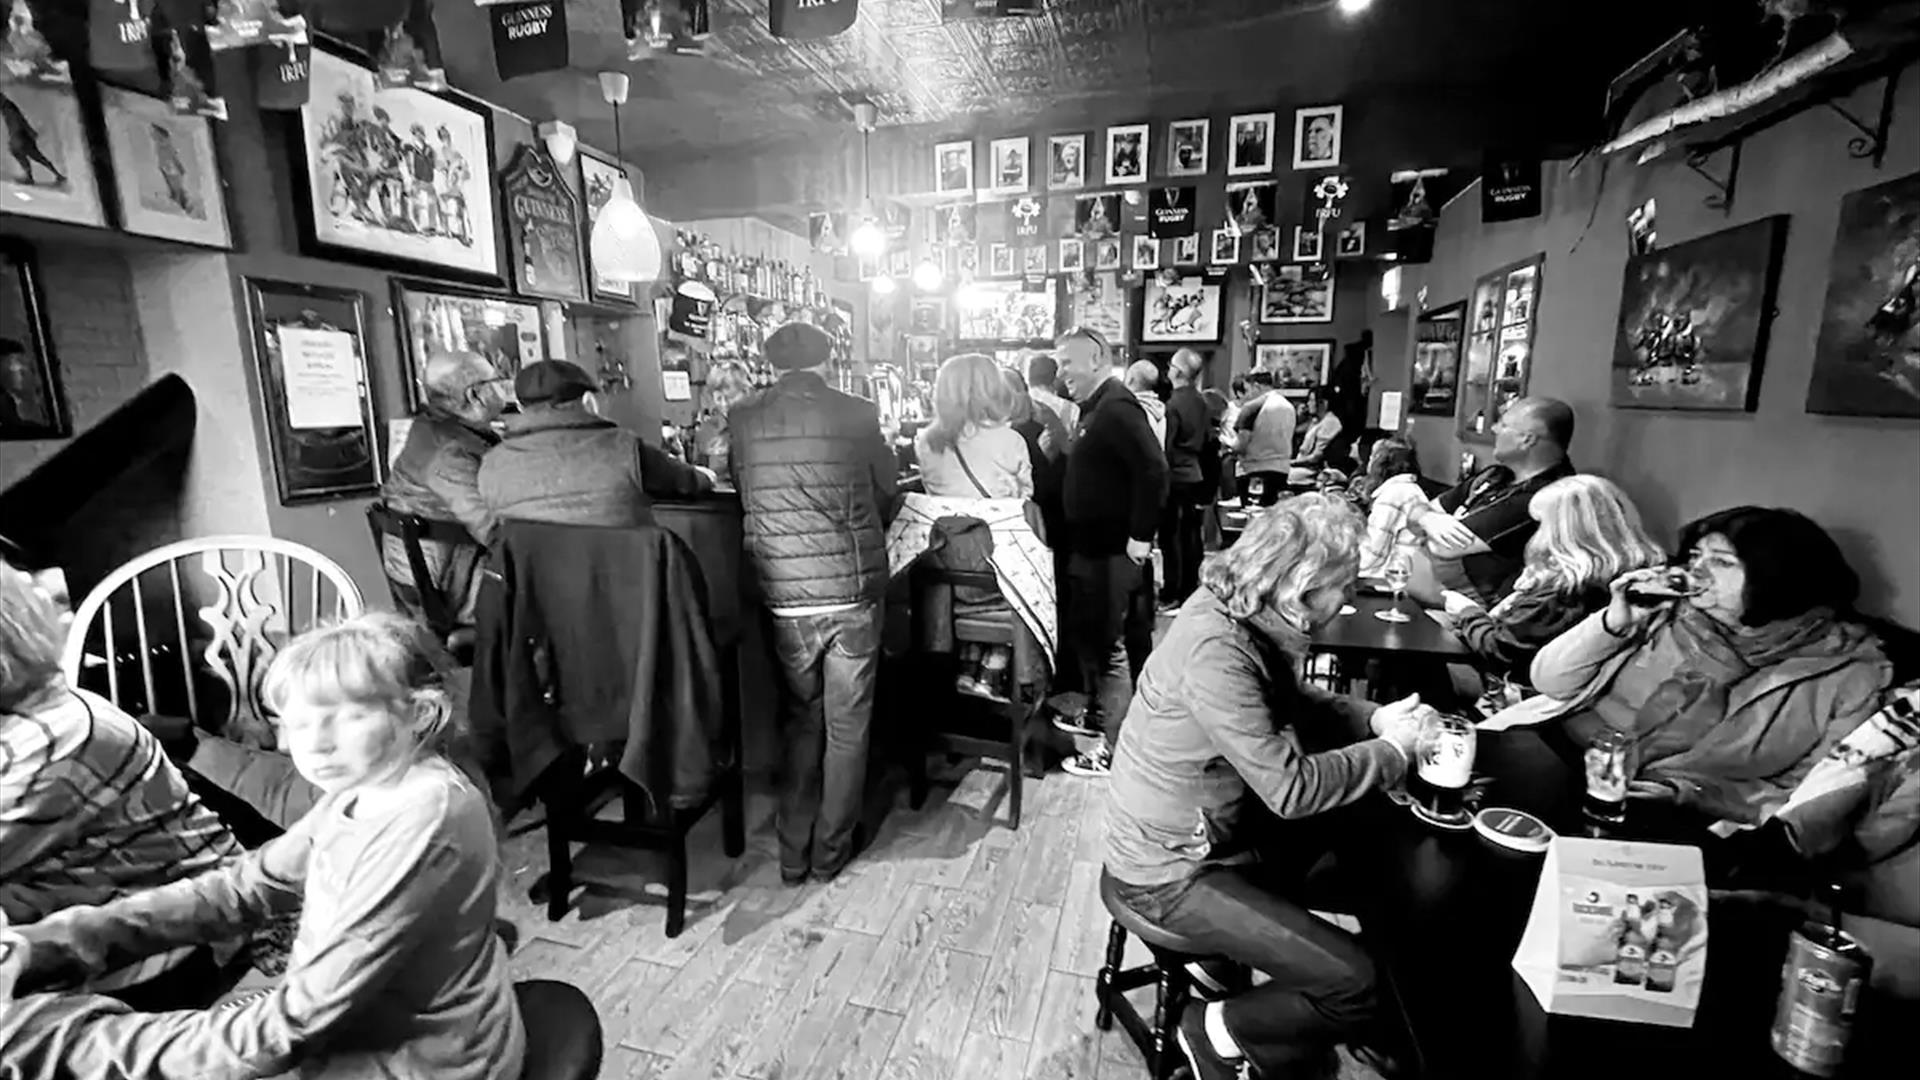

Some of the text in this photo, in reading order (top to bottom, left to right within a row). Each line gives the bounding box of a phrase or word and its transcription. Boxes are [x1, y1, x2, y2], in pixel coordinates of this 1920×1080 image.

[508, 18, 548, 40] RUGBY
[1495, 192, 1526, 202] RUGBY
[1158, 214, 1186, 223] RUGBY
[1016, 225, 1038, 236] IRFU
